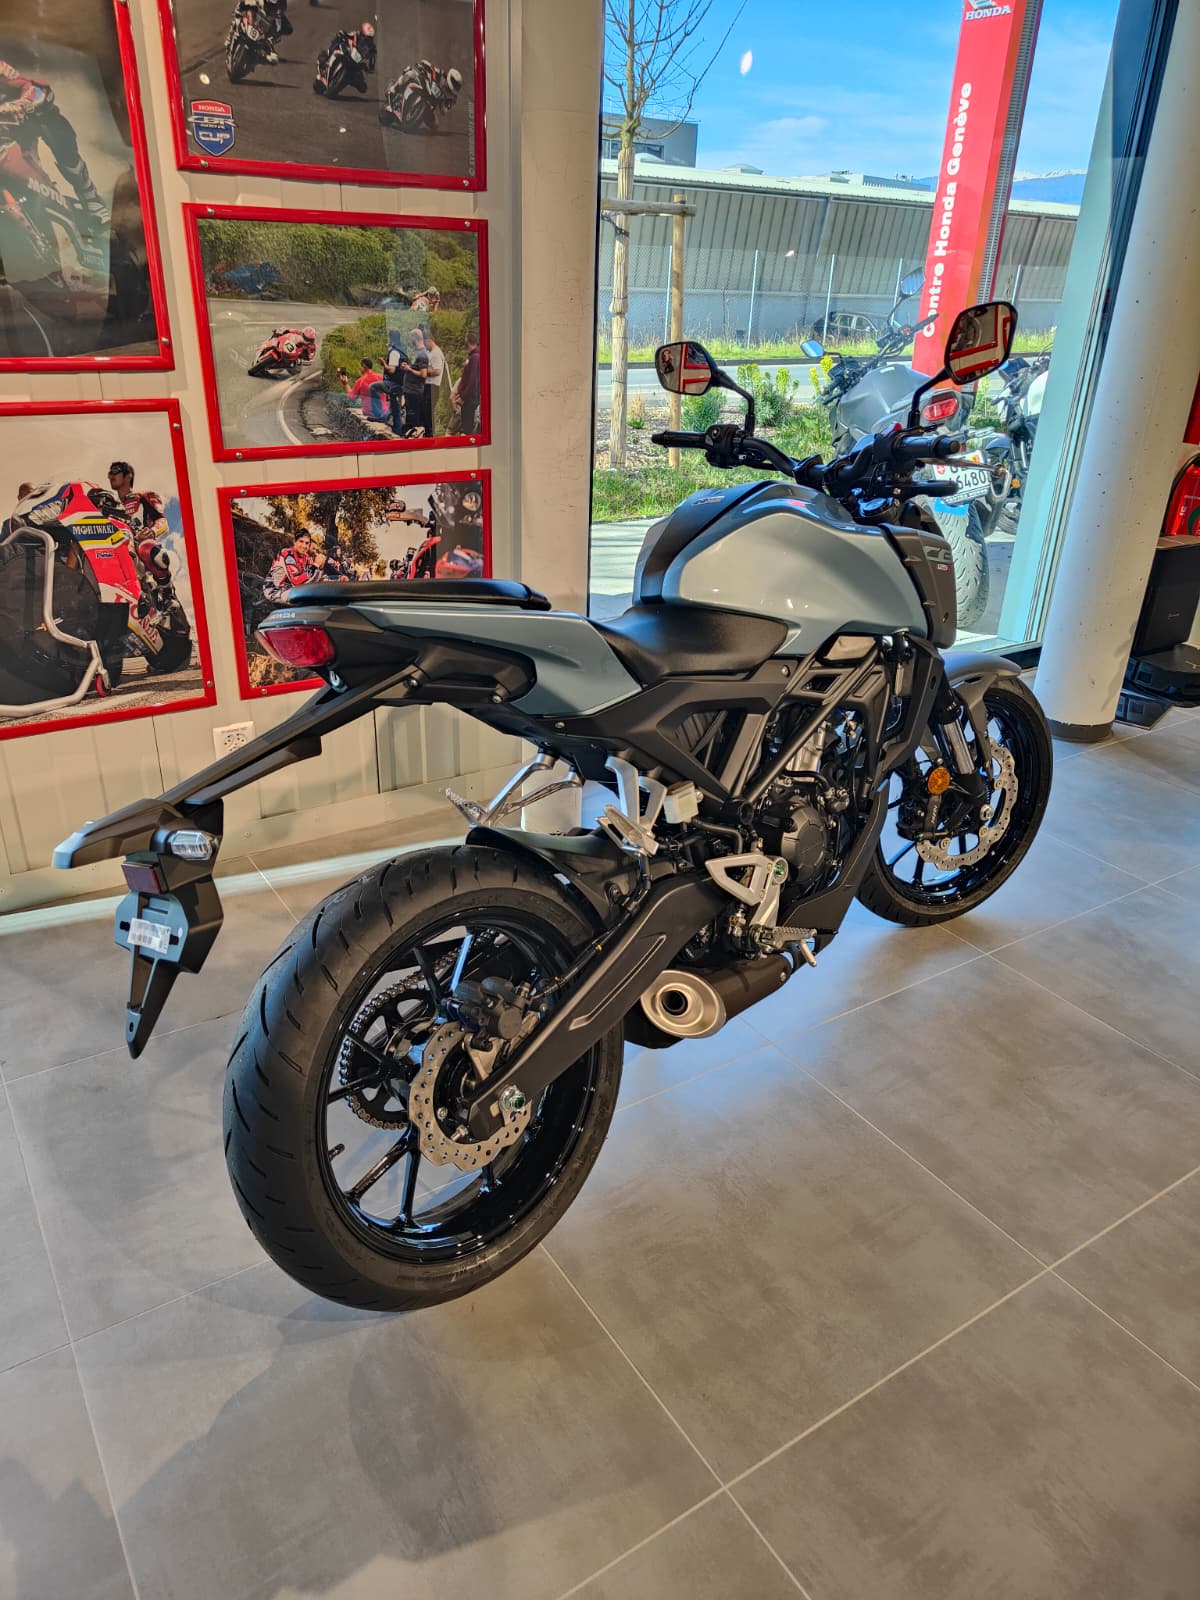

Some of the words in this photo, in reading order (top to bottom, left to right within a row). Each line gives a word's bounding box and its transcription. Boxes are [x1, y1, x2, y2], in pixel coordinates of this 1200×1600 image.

[965, 5, 1011, 20] HONDA
[198, 105, 226, 113] HONDA
[198, 131, 230, 144] CUP
[934, 182, 957, 256] Honda
[946, 83, 972, 175] Genève
[949, 469, 987, 490] 6480
[72, 524, 115, 535] MORIWAKI
